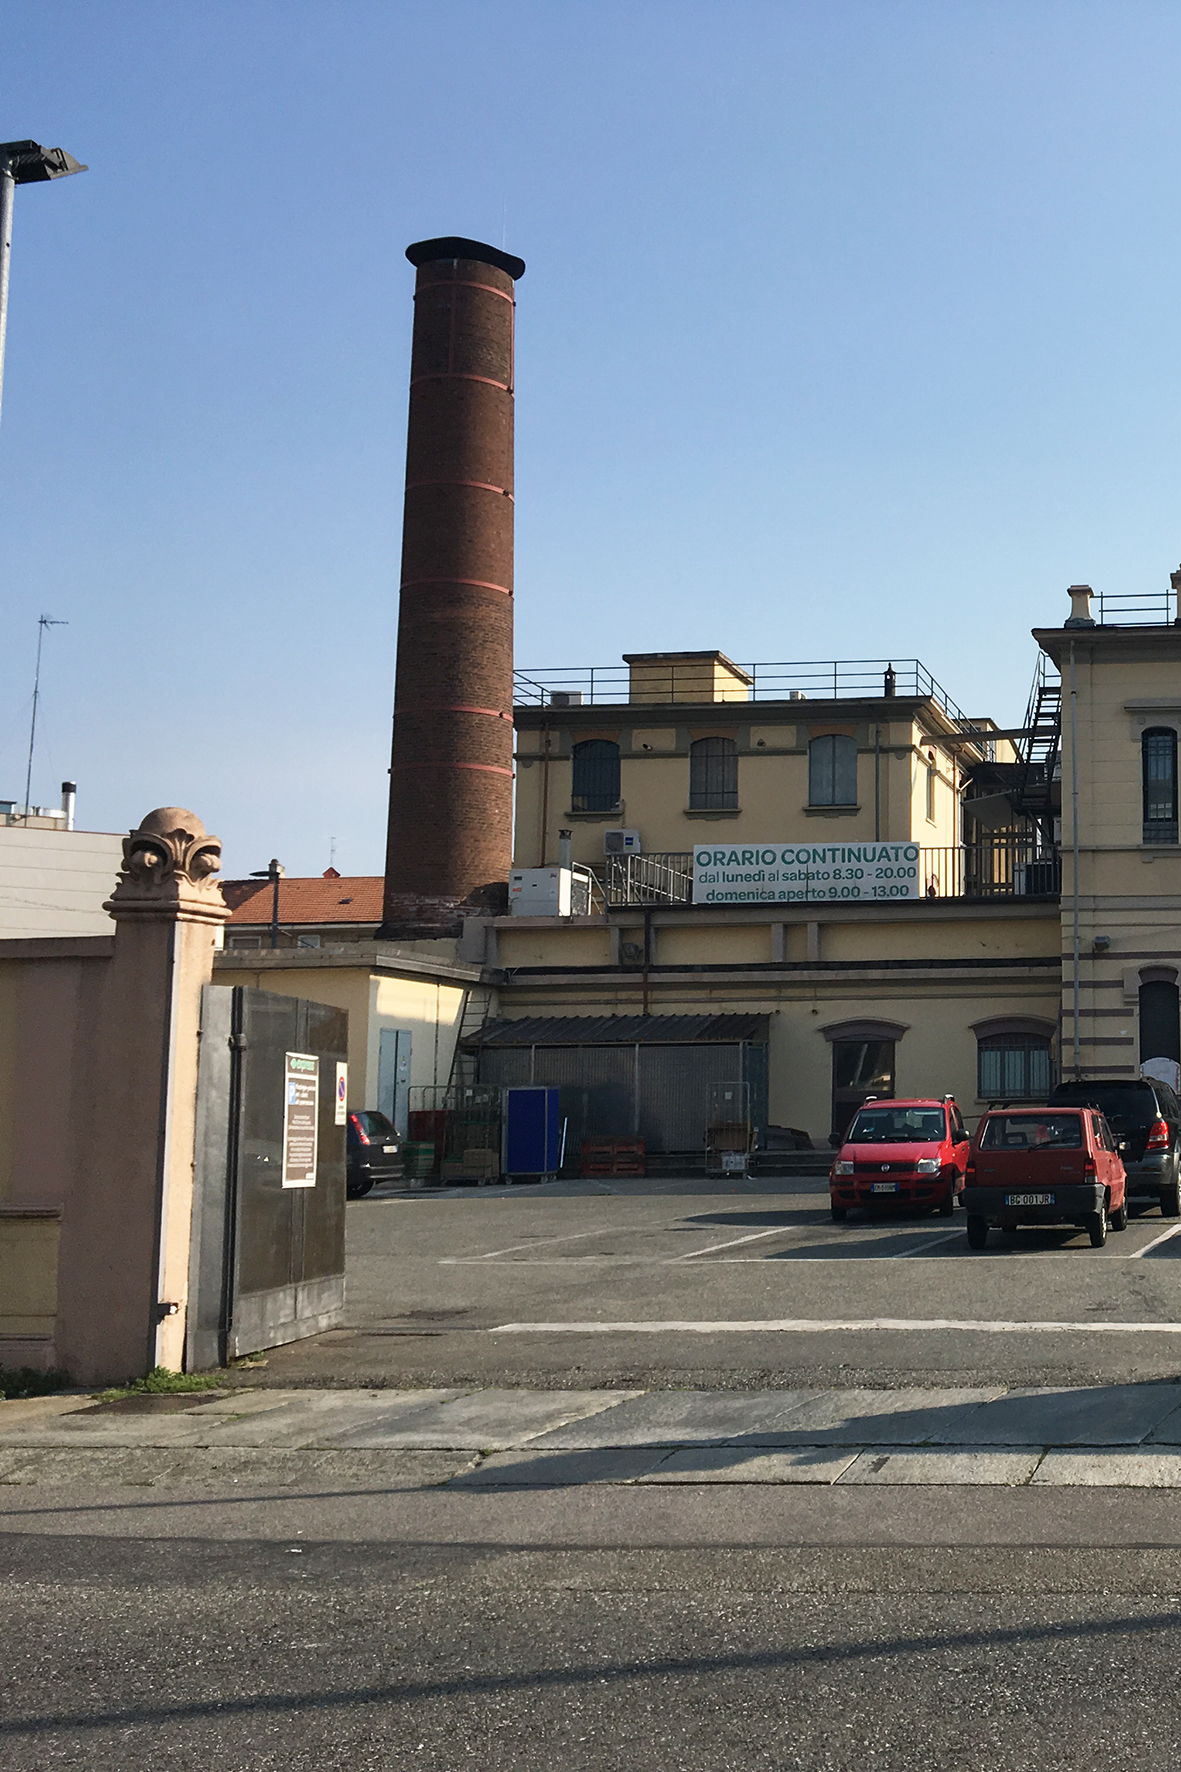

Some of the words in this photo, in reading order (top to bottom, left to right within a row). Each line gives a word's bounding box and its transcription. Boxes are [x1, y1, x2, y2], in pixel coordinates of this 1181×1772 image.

[696, 849, 777, 867] ORARIO
[781, 845, 919, 865] CONTINUATO
[698, 870, 719, 884] dal
[722, 869, 765, 883] lunedì
[768, 869, 779, 882] al
[782, 868, 830, 882] sabato
[832, 868, 864, 880] 8.30
[875, 866, 917, 879] 20.00
[706, 888, 774, 902] domenica
[778, 887, 825, 902] aperto
[828, 886, 861, 899] 9.00
[872, 885, 909, 898] 13.00
